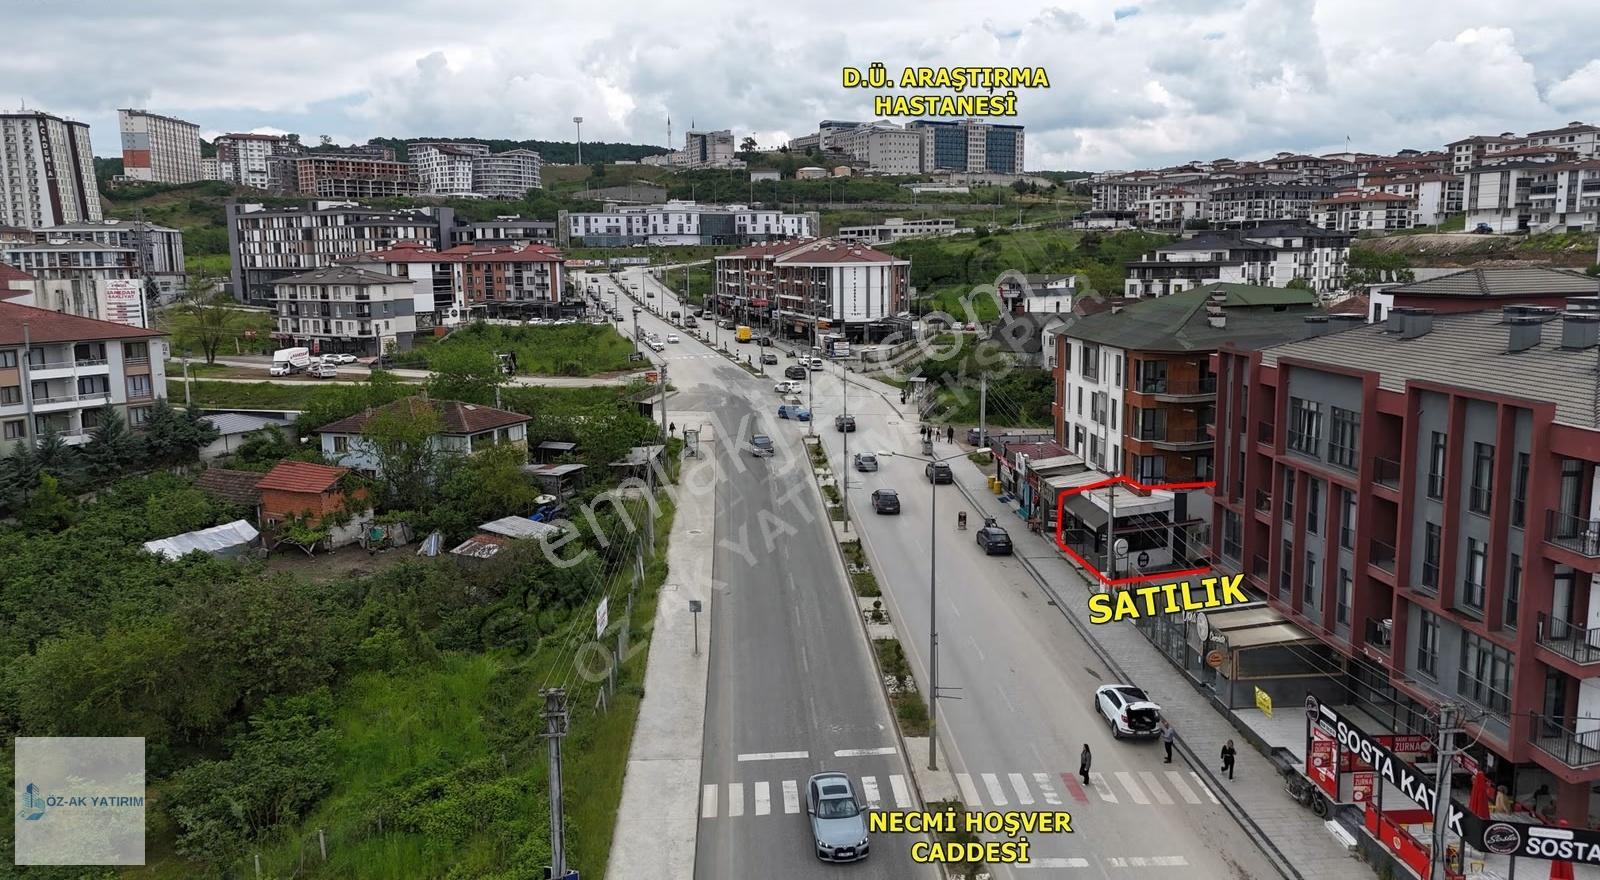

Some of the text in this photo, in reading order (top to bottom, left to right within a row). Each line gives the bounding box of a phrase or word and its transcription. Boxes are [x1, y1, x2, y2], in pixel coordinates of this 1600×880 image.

[39, 120, 54, 177] ACADEMIA
[1394, 742, 1420, 752] ZURNA
[1337, 721, 1464, 838] SOSTA KATK
